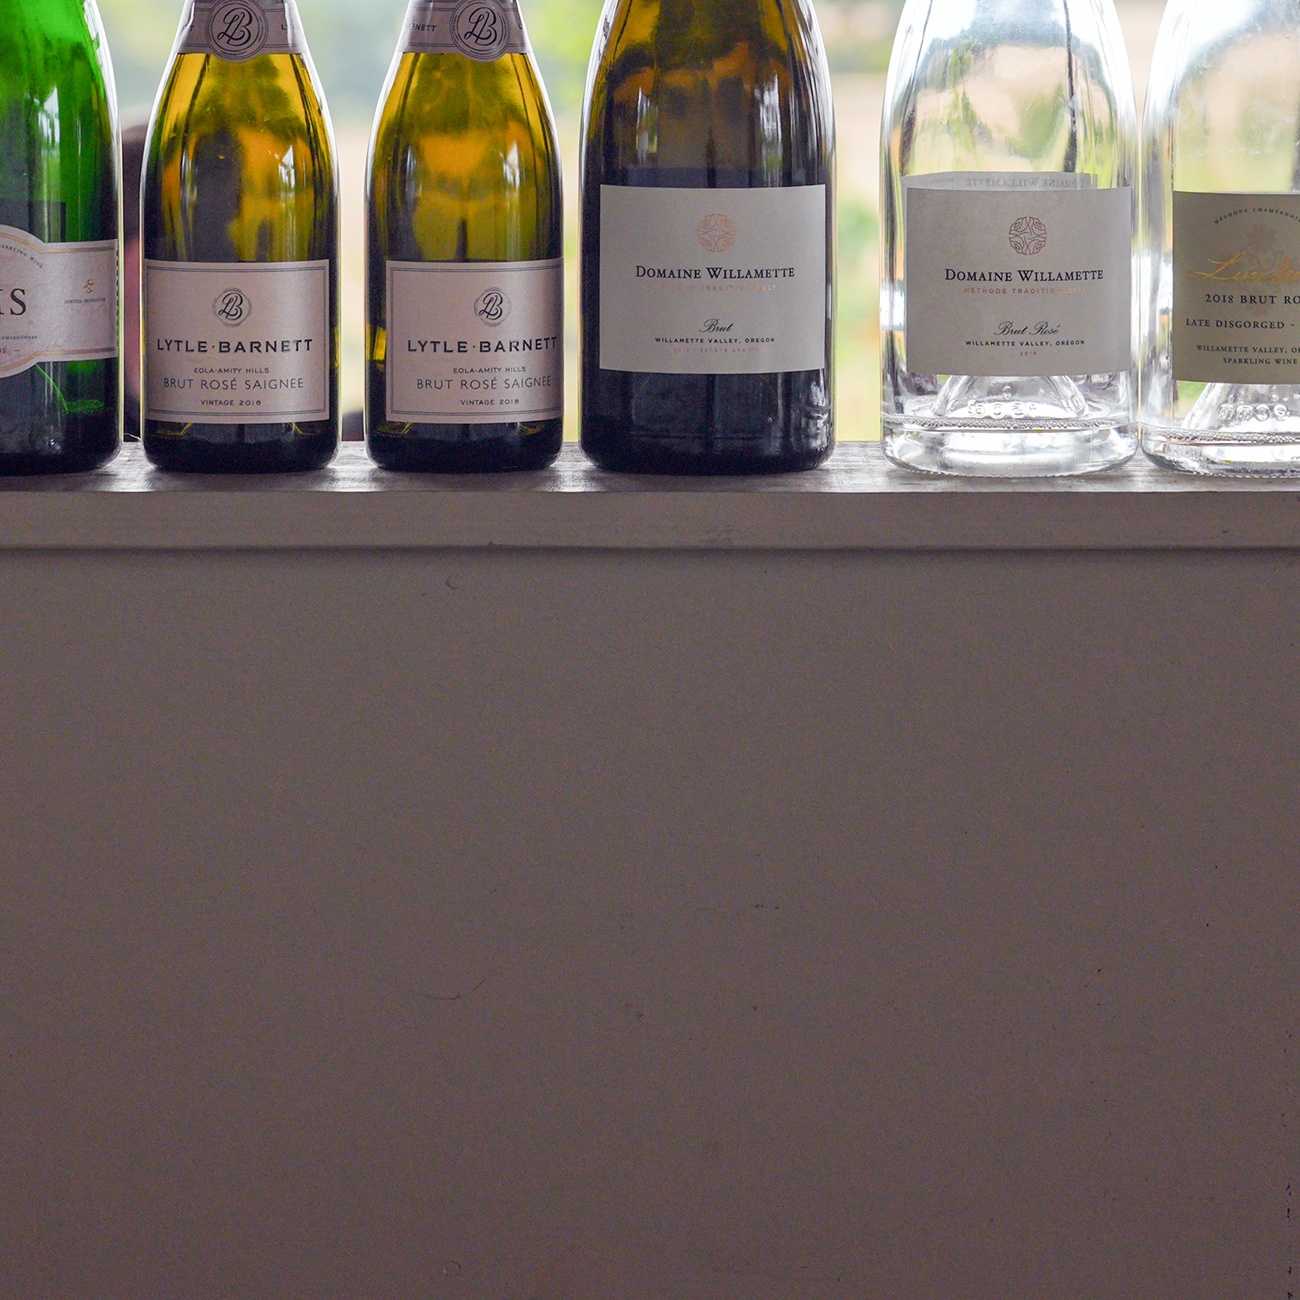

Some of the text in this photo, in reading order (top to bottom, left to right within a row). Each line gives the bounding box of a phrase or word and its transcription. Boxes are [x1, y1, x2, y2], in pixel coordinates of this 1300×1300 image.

[1214, 209, 1248, 225] MÉTHODE
[30, 256, 44, 269] WINE
[636, 266, 795, 280] DOMAINE WILLAMETTE
[945, 269, 1103, 282] DOMAINE WILLAMETTE
[964, 286, 1007, 294] MÉTHODE
[1206, 294, 1234, 303] 2018
[1240, 296, 1277, 305] BRUT
[699, 318, 734, 333] Brut
[994, 321, 1060, 336] Brut Rosé
[1186, 318, 1211, 327] LATE
[1216, 320, 1285, 330] DISGORGED
[1196, 345, 1249, 353] WILLAMETTE
[1252, 346, 1288, 354] VALLEY,
[164, 378, 194, 389] BRUT
[201, 378, 237, 390] ROSÉ
[417, 379, 453, 389] BRUT
[460, 378, 498, 390] ROSÉ
